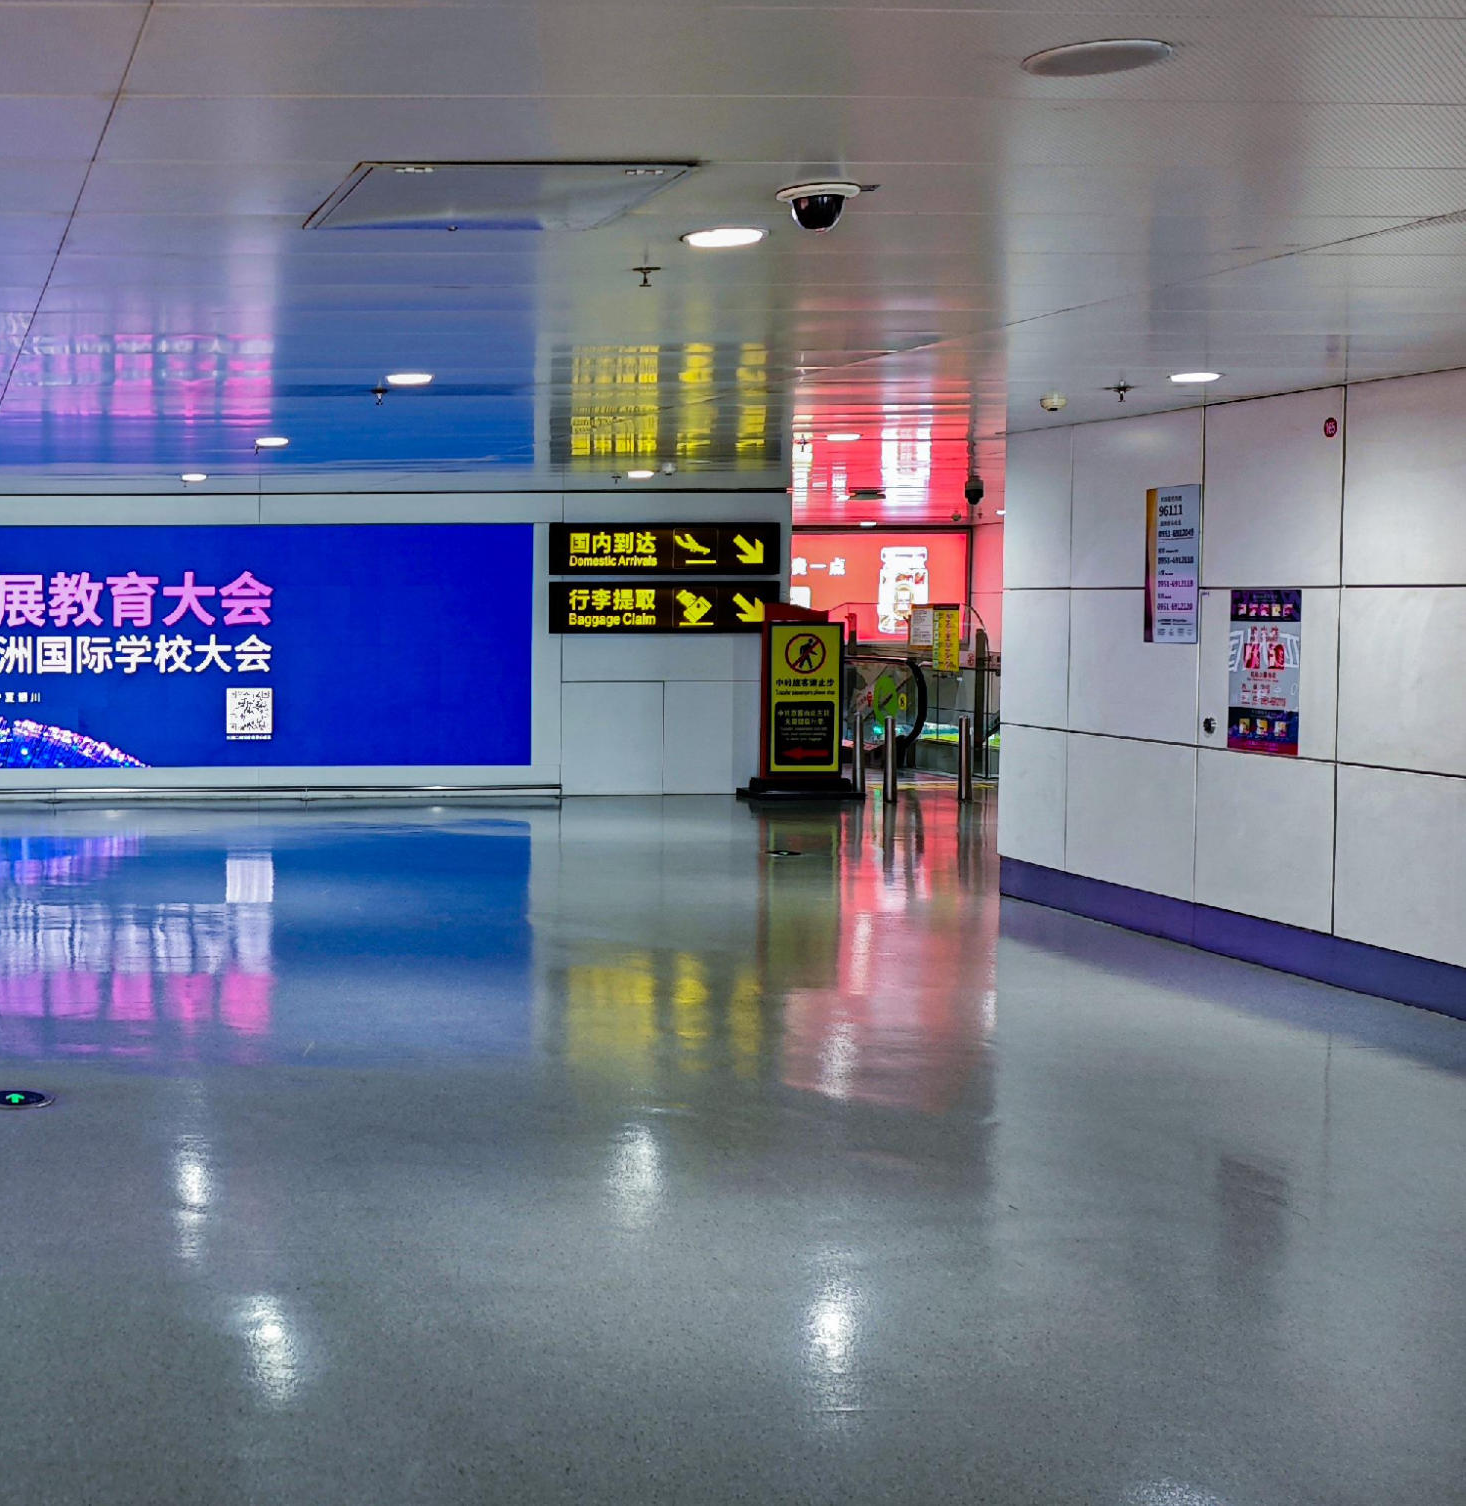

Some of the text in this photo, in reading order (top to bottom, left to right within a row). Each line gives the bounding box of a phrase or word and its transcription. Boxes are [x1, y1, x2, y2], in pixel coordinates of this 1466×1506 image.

[1158, 504, 1183, 517] 96111
[569, 532, 657, 554] 国内到达
[569, 555, 658, 567] Domestic Arrivals
[569, 589, 656, 611] 行李提取
[569, 613, 656, 627] Baggage Claim
